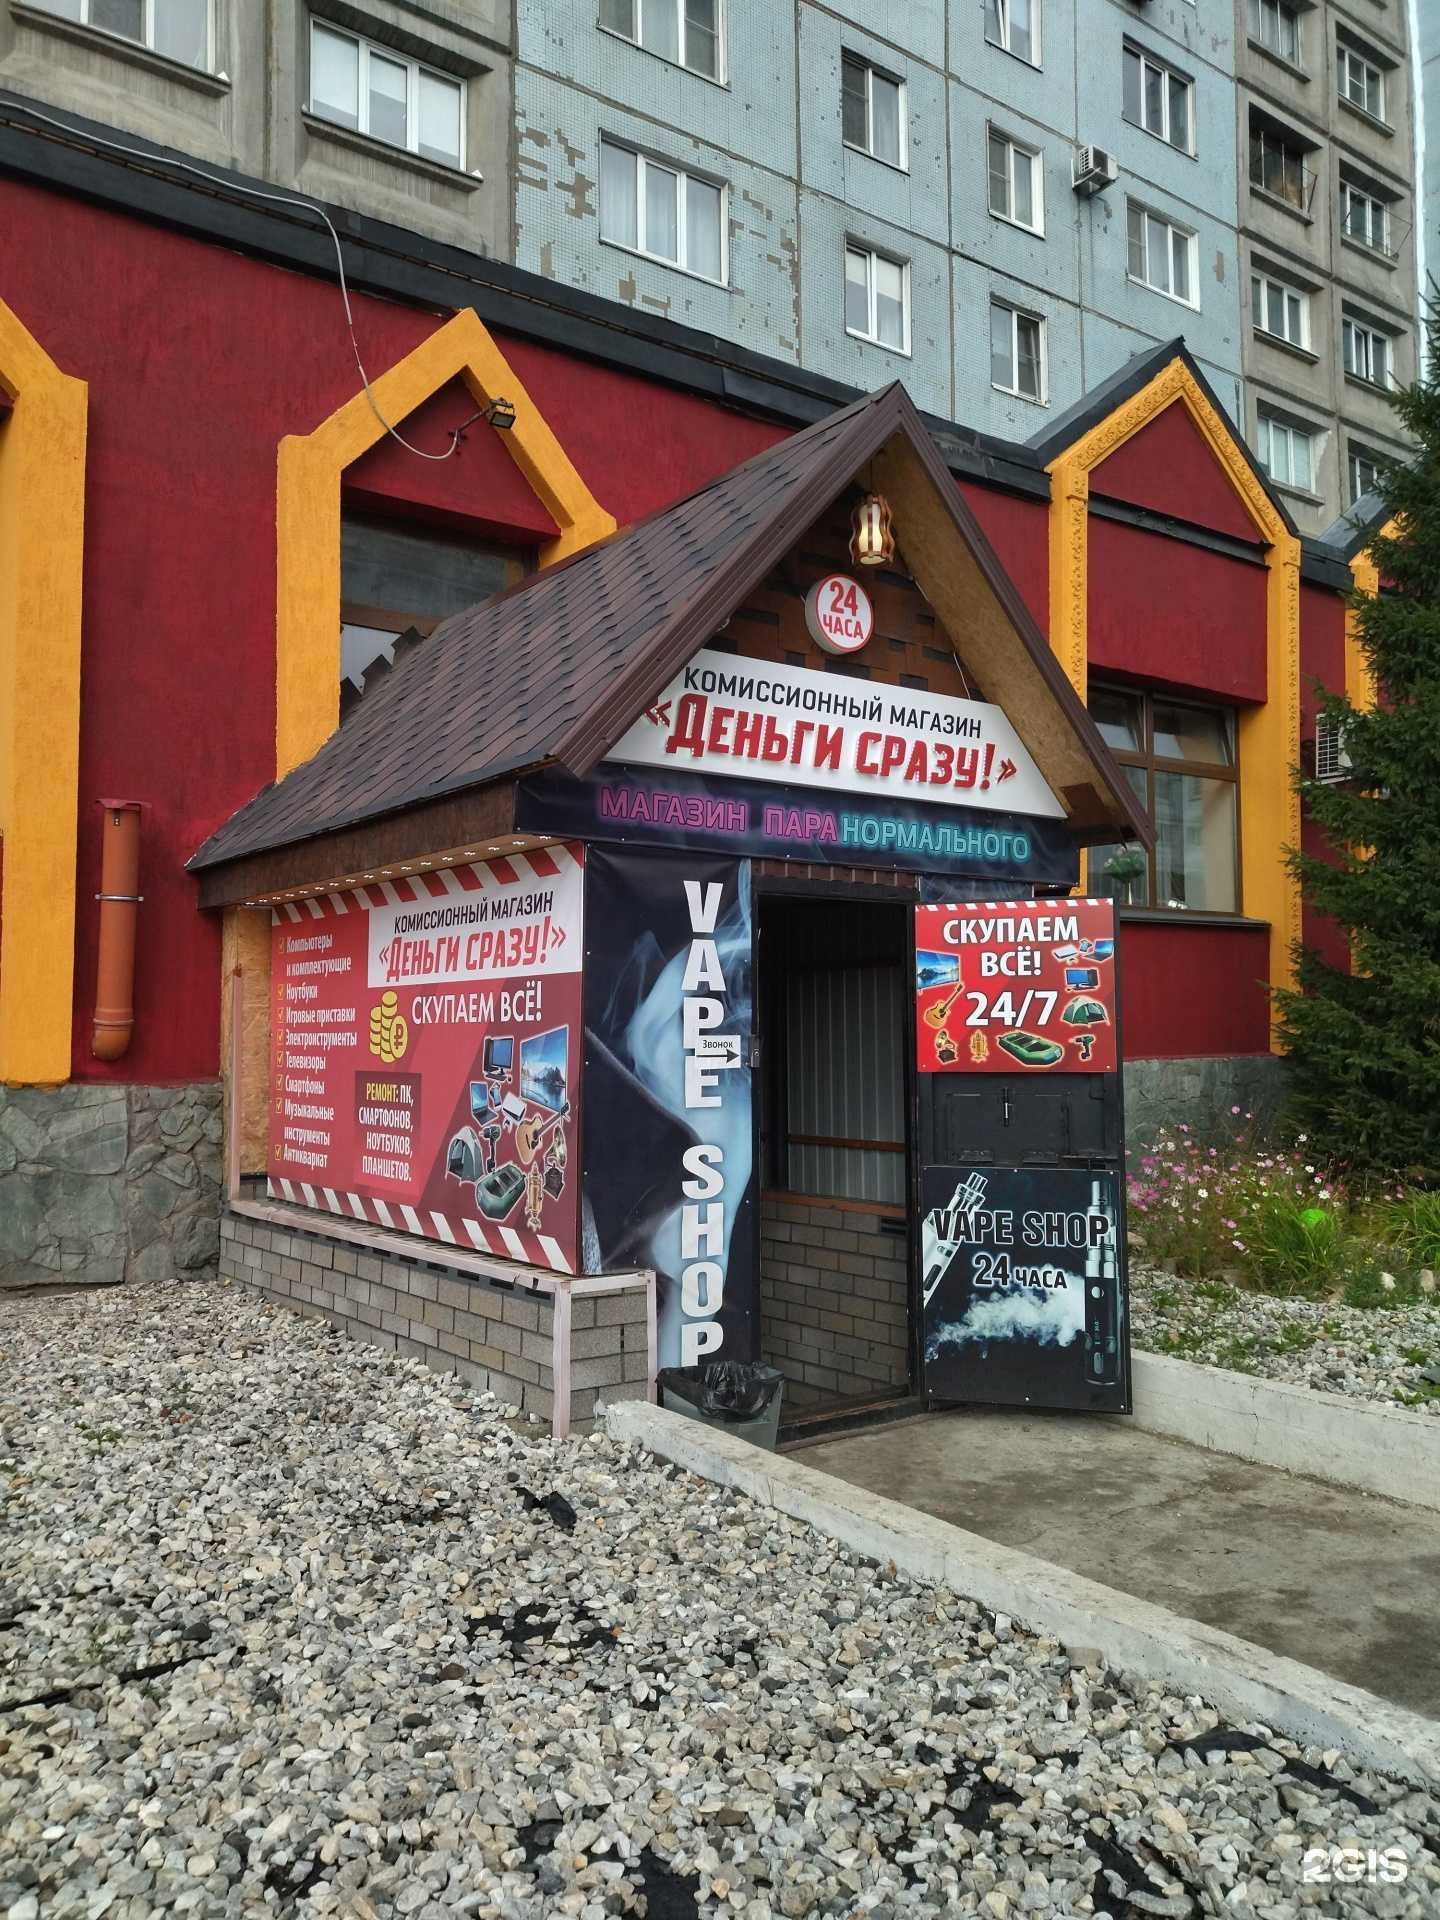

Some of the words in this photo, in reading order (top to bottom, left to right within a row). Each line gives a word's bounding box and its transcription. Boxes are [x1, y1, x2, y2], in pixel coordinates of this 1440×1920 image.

[829, 581, 858, 616] 24
[822, 615, 864, 640] ЧАСА
[684, 667, 883, 722] КОМИССИОННЫЙ
[890, 706, 982, 739] МАГАЗИН
[855, 731, 1017, 791] СРАЗУ!»
[601, 786, 746, 831] МАГАЗИН
[394, 897, 488, 935] КОМИССИОННЫЙ
[491, 891, 553, 921] МАГАЗИН
[286, 934, 333, 953] Компьютеры
[943, 916, 1079, 944] СКУПАЕМ
[379, 935, 460, 983] «ДЕНЬГИ
[465, 915, 567, 971] СРАЗУ!»
[981, 945, 1041, 977] ВСЁ!
[292, 956, 352, 978] комплектующие
[286, 981, 318, 1004] Ноутбуки
[411, 991, 494, 1025] СКУПАЕМ
[500, 980, 542, 1023] ВСЁ!
[681, 880, 727, 1108] VAPE
[286, 1006, 316, 1028] Игровые
[316, 1006, 356, 1028] приставки
[965, 989, 1058, 1027] 24/7
[702, 1039, 734, 1049] Звонок
[285, 1050, 326, 1074] Телевизоры
[285, 1074, 325, 1097] Смартфоны
[366, 1082, 399, 1103] РЕМОНТ:
[400, 1084, 414, 1107] ПК,
[284, 1098, 335, 1121] Музыкальные
[358, 1106, 413, 1133] СМАРТФОНОВ,
[284, 1125, 331, 1147] инструменты
[366, 1131, 413, 1159] НОУТБУКОВ,
[283, 1143, 328, 1171] Антиквариат
[362, 1155, 412, 1182] ПЛАНШЕТОВ.
[932, 1208, 1013, 1245] VAPE
[1022, 1210, 1110, 1249] SHOP
[681, 1145, 724, 1367] SHOP
[972, 1252, 1010, 1287] 24
[1014, 1267, 1068, 1289] ЧАСА
